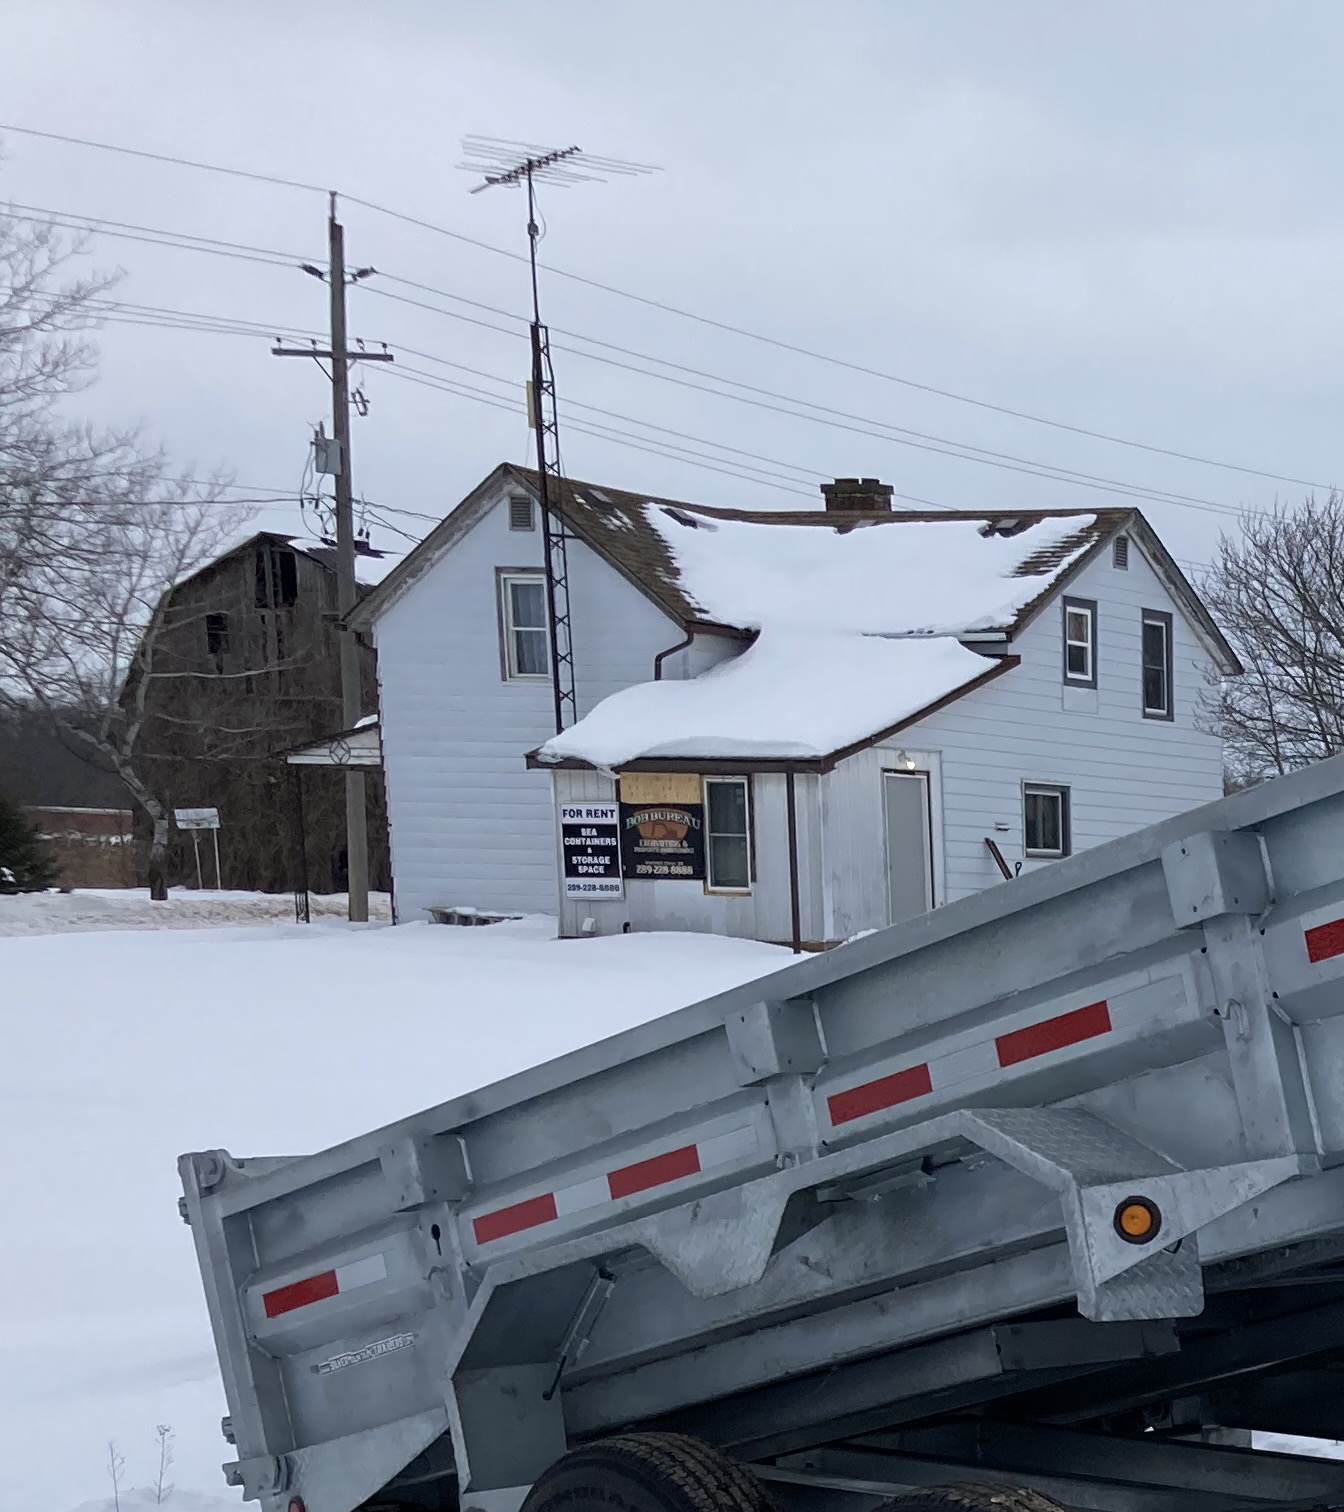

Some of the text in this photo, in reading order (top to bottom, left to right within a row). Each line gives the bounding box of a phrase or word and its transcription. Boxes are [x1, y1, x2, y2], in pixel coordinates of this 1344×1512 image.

[562, 808, 616, 818] FOR RENT
[650, 811, 701, 829] BUREAU
[580, 828, 598, 836] SEA
[564, 837, 617, 846] CONTAINERS
[571, 856, 611, 864] STORAGE
[578, 865, 605, 874] SPACE
